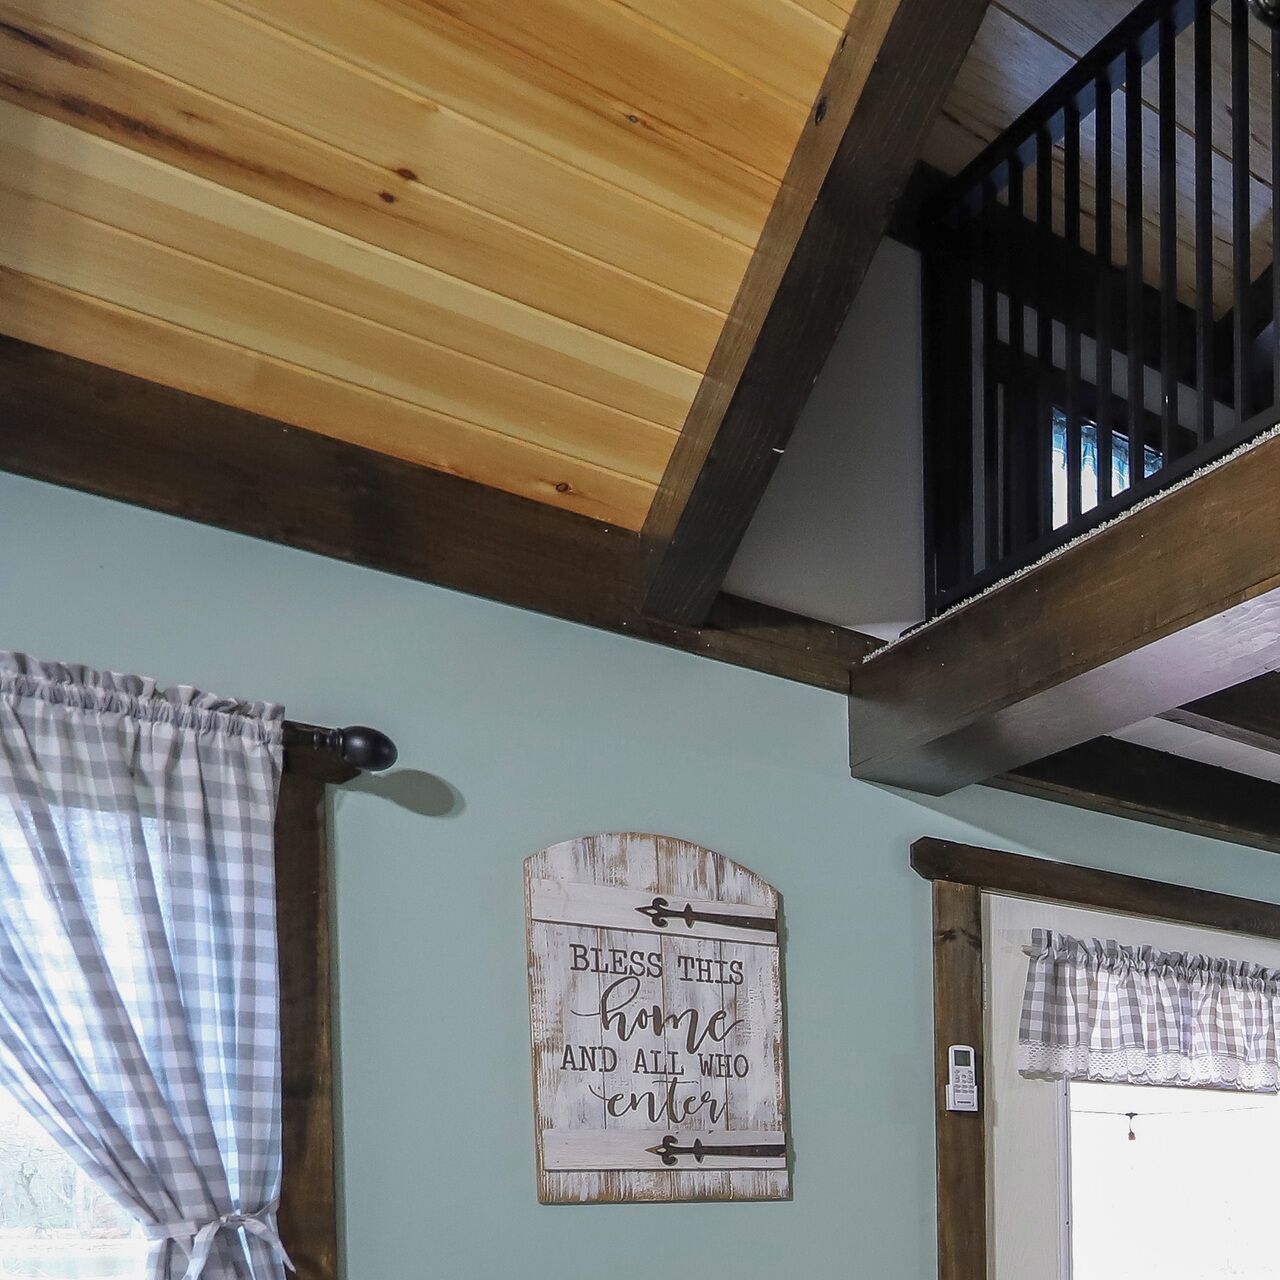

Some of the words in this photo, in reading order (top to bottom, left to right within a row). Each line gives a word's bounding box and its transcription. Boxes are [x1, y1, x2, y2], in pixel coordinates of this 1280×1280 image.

[569, 943, 663, 977] BLESS
[677, 955, 744, 985] THIS
[570, 976, 744, 1054] home
[560, 1044, 618, 1073] AND
[633, 1049, 685, 1076] ALL
[699, 1053, 749, 1079] WHO
[588, 1077, 728, 1124] enter
